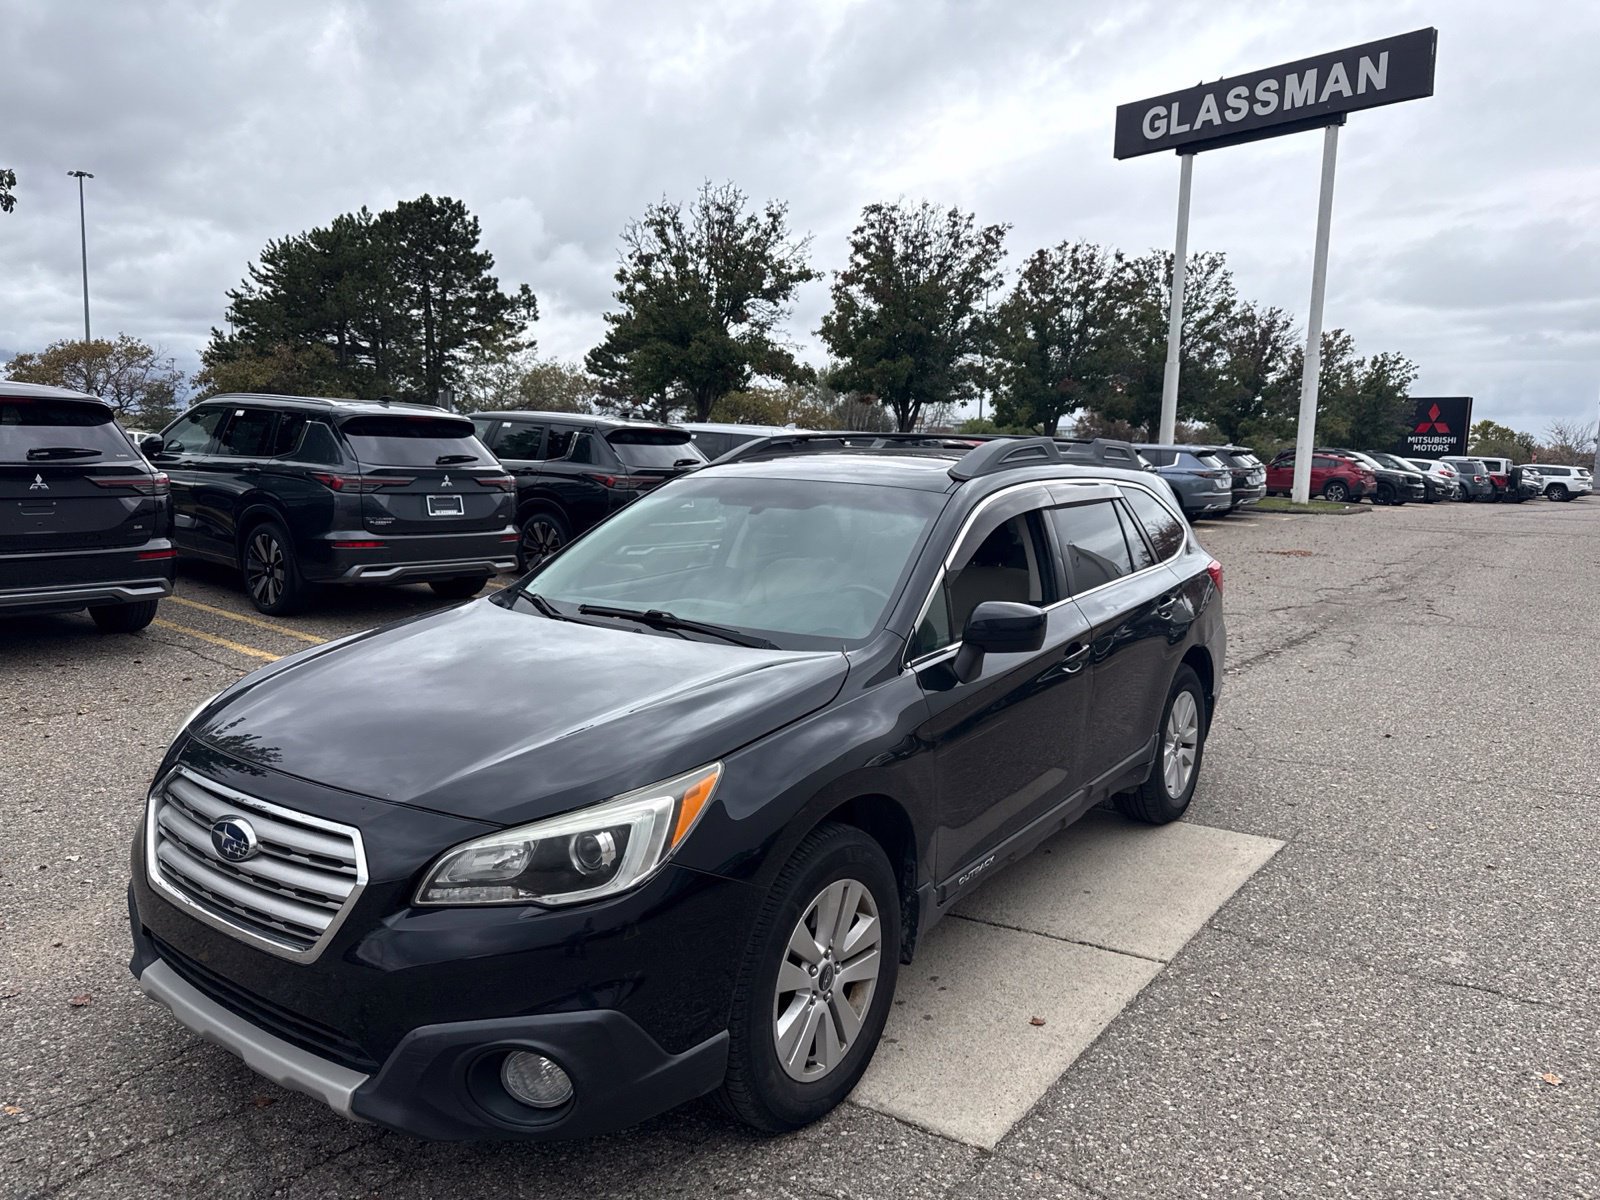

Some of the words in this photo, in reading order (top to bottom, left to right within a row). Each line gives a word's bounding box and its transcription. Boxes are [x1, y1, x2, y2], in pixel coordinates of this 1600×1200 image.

[1142, 51, 1389, 140] GLASSMAN
[1407, 436, 1457, 444] MITSUBISHI
[1412, 444, 1449, 452] MOTORS
